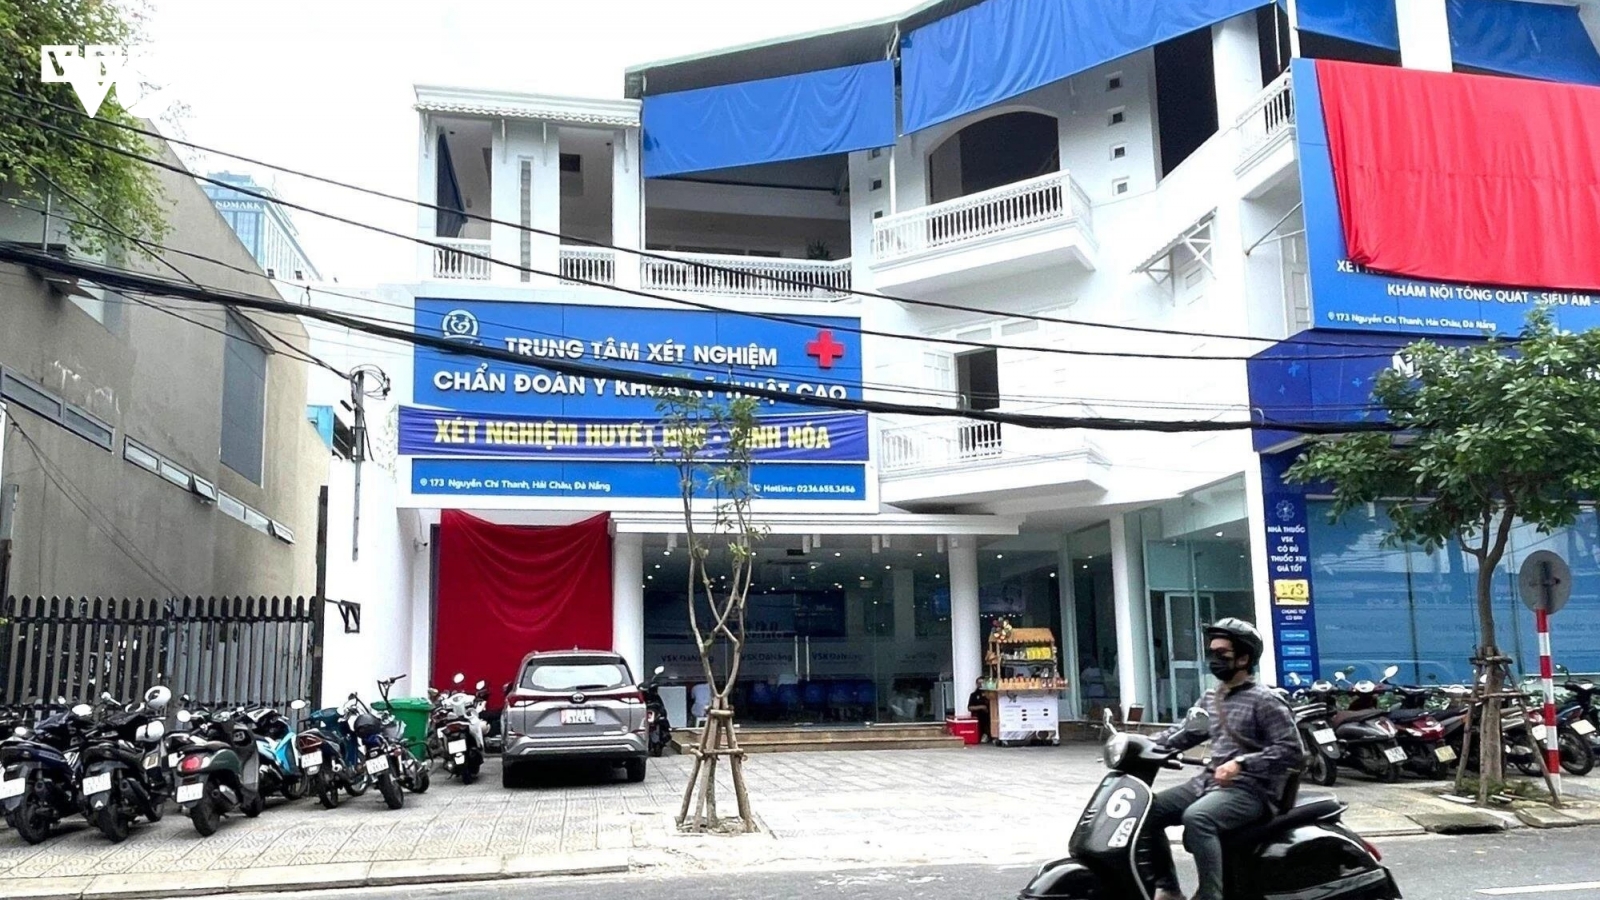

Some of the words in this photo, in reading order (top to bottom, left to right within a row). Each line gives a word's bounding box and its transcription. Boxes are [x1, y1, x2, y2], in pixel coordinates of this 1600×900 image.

[1387, 282, 1426, 298] KHÁM
[1430, 284, 1454, 300] NỘI
[1456, 284, 1492, 301] TỔNG
[1336, 312, 1350, 322] 173
[505, 337, 585, 359] TRUNG
[591, 337, 640, 361] TÂM
[646, 338, 686, 362] XÉT
[694, 342, 777, 370] NGHIỆM
[433, 362, 506, 392] CHẨN
[514, 371, 585, 394] ĐOÁN
[434, 416, 479, 444] XÉT
[486, 420, 578, 450] NGHIỆM
[585, 420, 654, 447] HUYẾT
[788, 422, 831, 449] HÓA
[430, 478, 445, 487] 173
[448, 478, 483, 490] Nguyễn
[484, 479, 499, 488] Chí
[763, 484, 796, 493] Hotline:
[1106, 787, 1136, 818] 6
